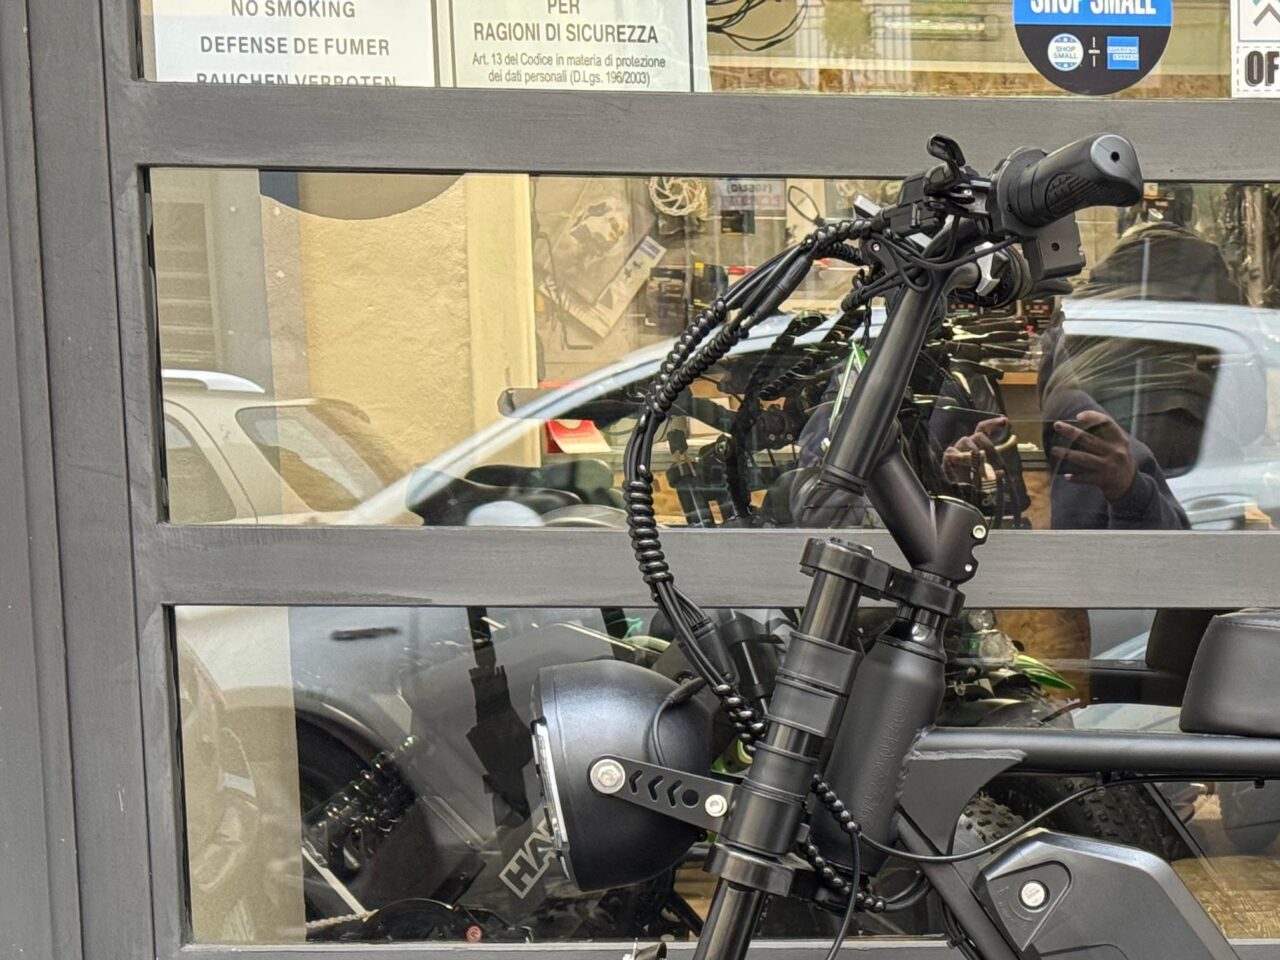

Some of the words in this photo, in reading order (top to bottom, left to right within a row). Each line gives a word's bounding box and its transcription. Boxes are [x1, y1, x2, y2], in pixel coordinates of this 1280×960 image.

[231, 0, 258, 16] NO
[264, 0, 356, 18] SMOKING
[547, 0, 580, 14] PER
[473, 22, 541, 42] RAGIONI
[546, 23, 561, 41] DI
[566, 24, 659, 43] SICUREZZA
[200, 35, 288, 54] DEFENSE
[294, 37, 319, 54] DE
[324, 38, 390, 56] FUMER
[472, 52, 489, 66] Art.
[491, 53, 503, 66] 13
[504, 53, 519, 66] del
[520, 53, 553, 66] Codice
[555, 54, 564, 66] in
[567, 54, 602, 67] materia
[604, 54, 613, 67] di
[616, 55, 666, 71] protezione
[488, 69, 502, 82] dei
[505, 70, 522, 82] dati
[525, 70, 567, 85] personali
[606, 71, 651, 87] 196/2003)
